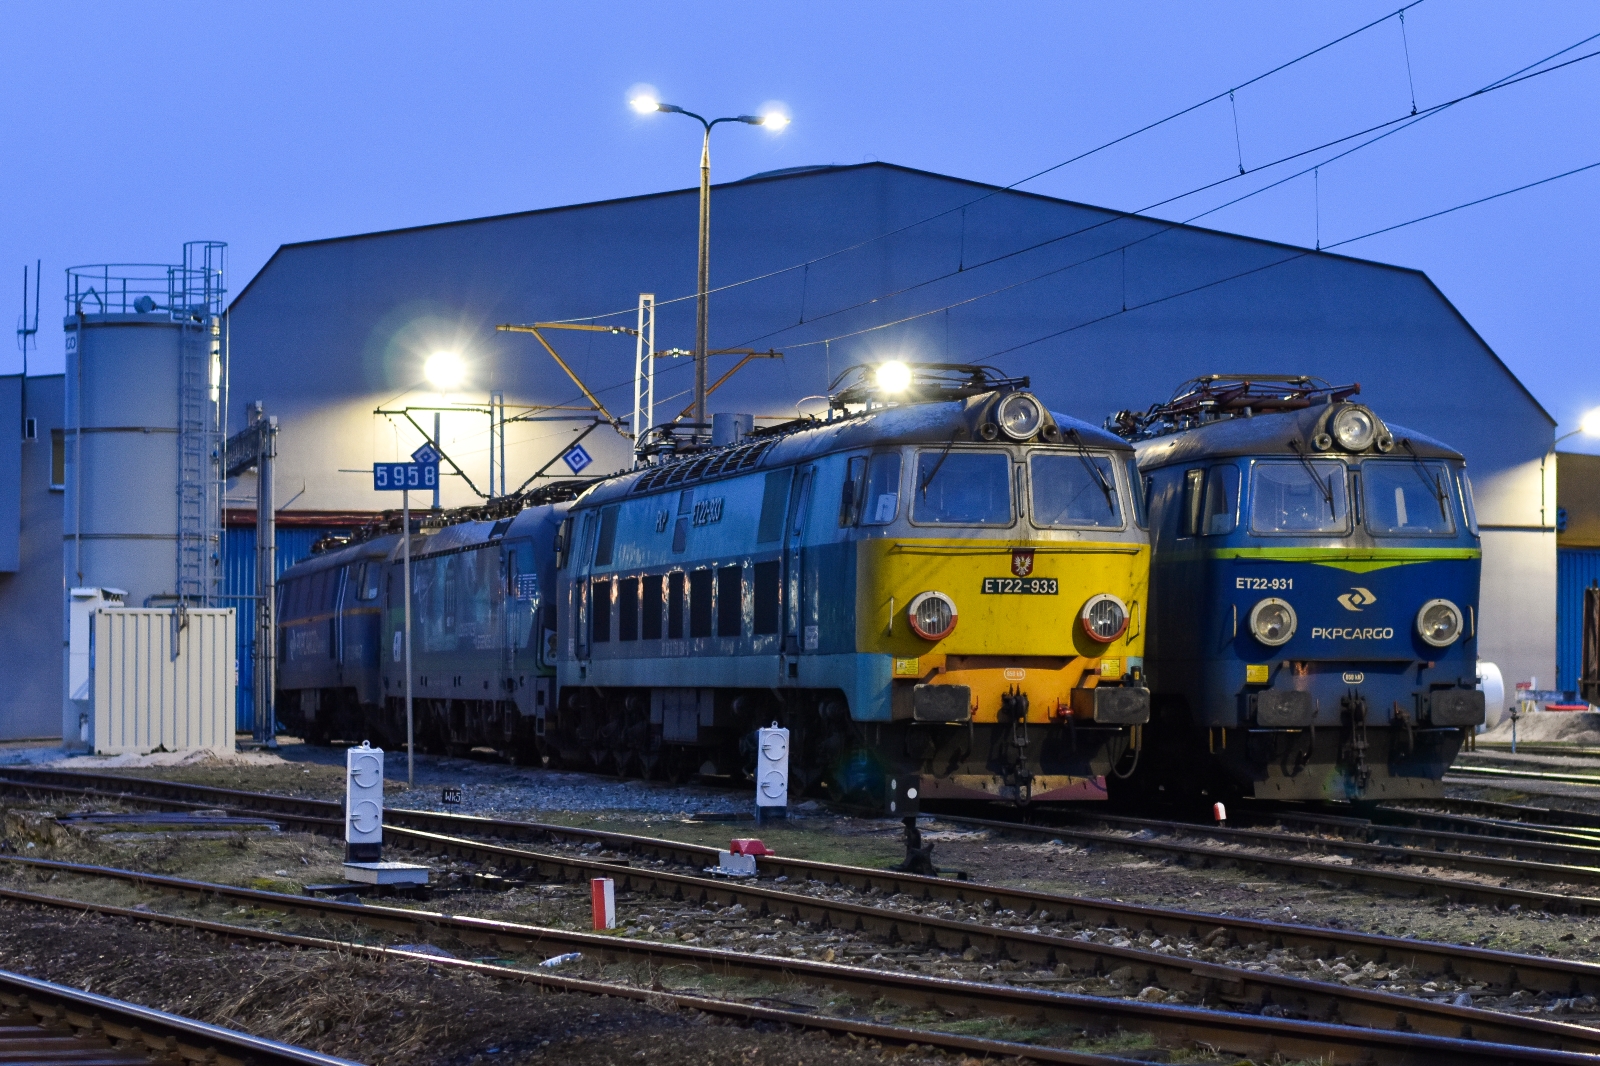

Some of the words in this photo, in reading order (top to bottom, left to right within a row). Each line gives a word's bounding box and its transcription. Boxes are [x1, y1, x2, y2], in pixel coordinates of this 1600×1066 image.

[376, 466, 436, 486] 5958
[984, 579, 1057, 594] ET22-933
[1236, 577, 1293, 590] ET22-931
